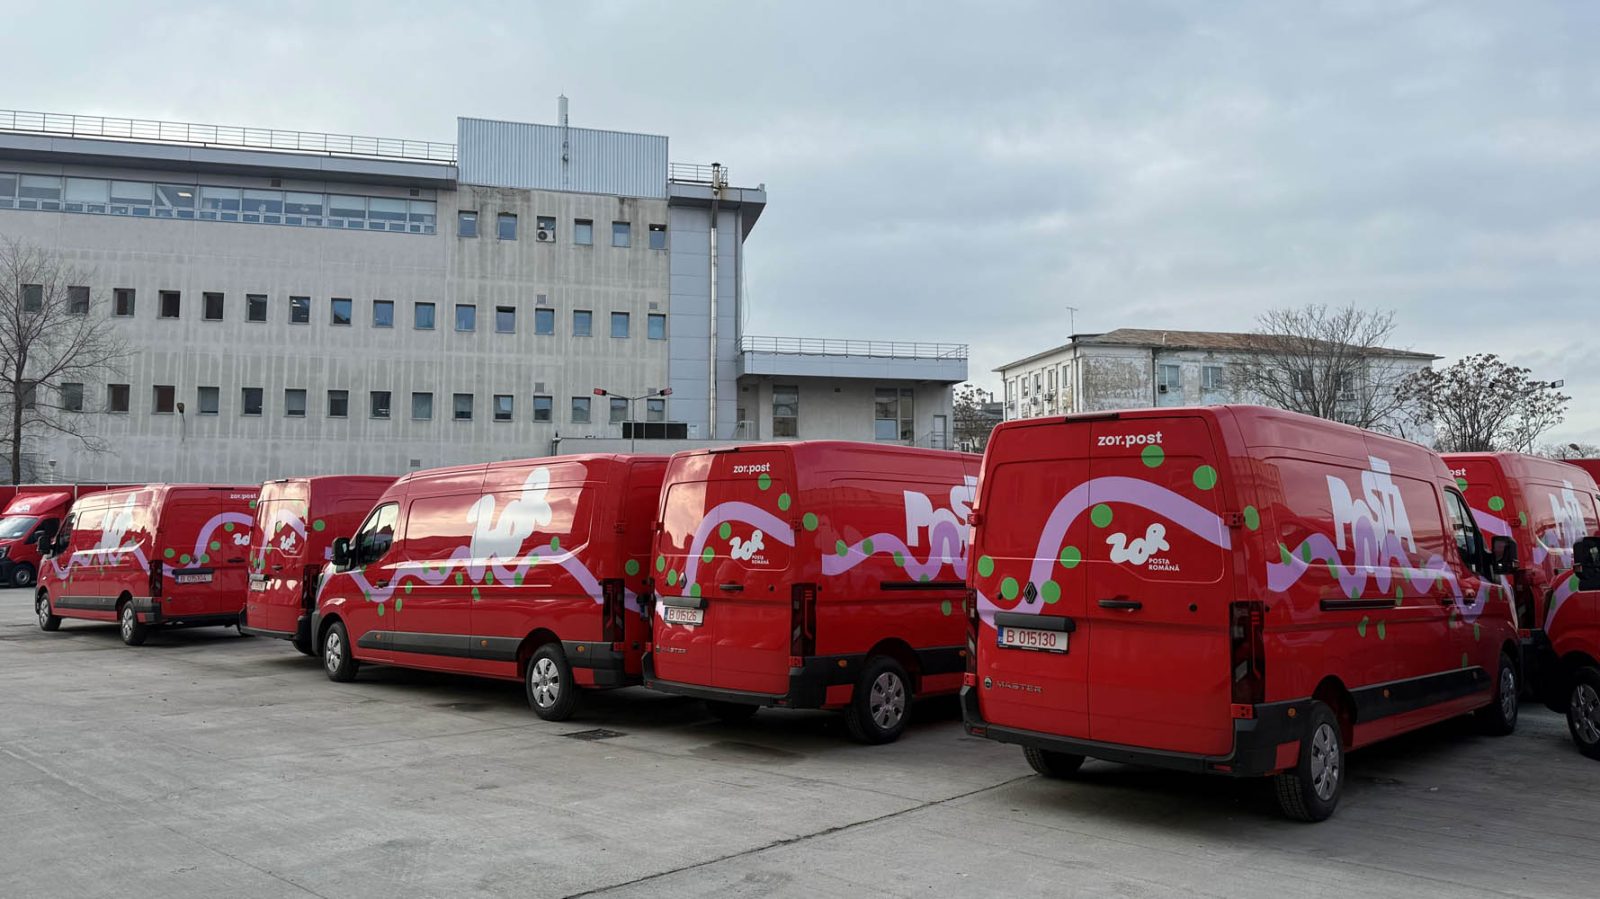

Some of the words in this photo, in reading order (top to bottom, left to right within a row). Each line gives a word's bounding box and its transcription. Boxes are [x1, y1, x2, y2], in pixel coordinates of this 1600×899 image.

[1097, 431, 1162, 448] zor.post
[733, 462, 770, 475] zor.post
[669, 610, 675, 620] B
[1006, 629, 1015, 643] B
[1019, 630, 1057, 647] 015130
